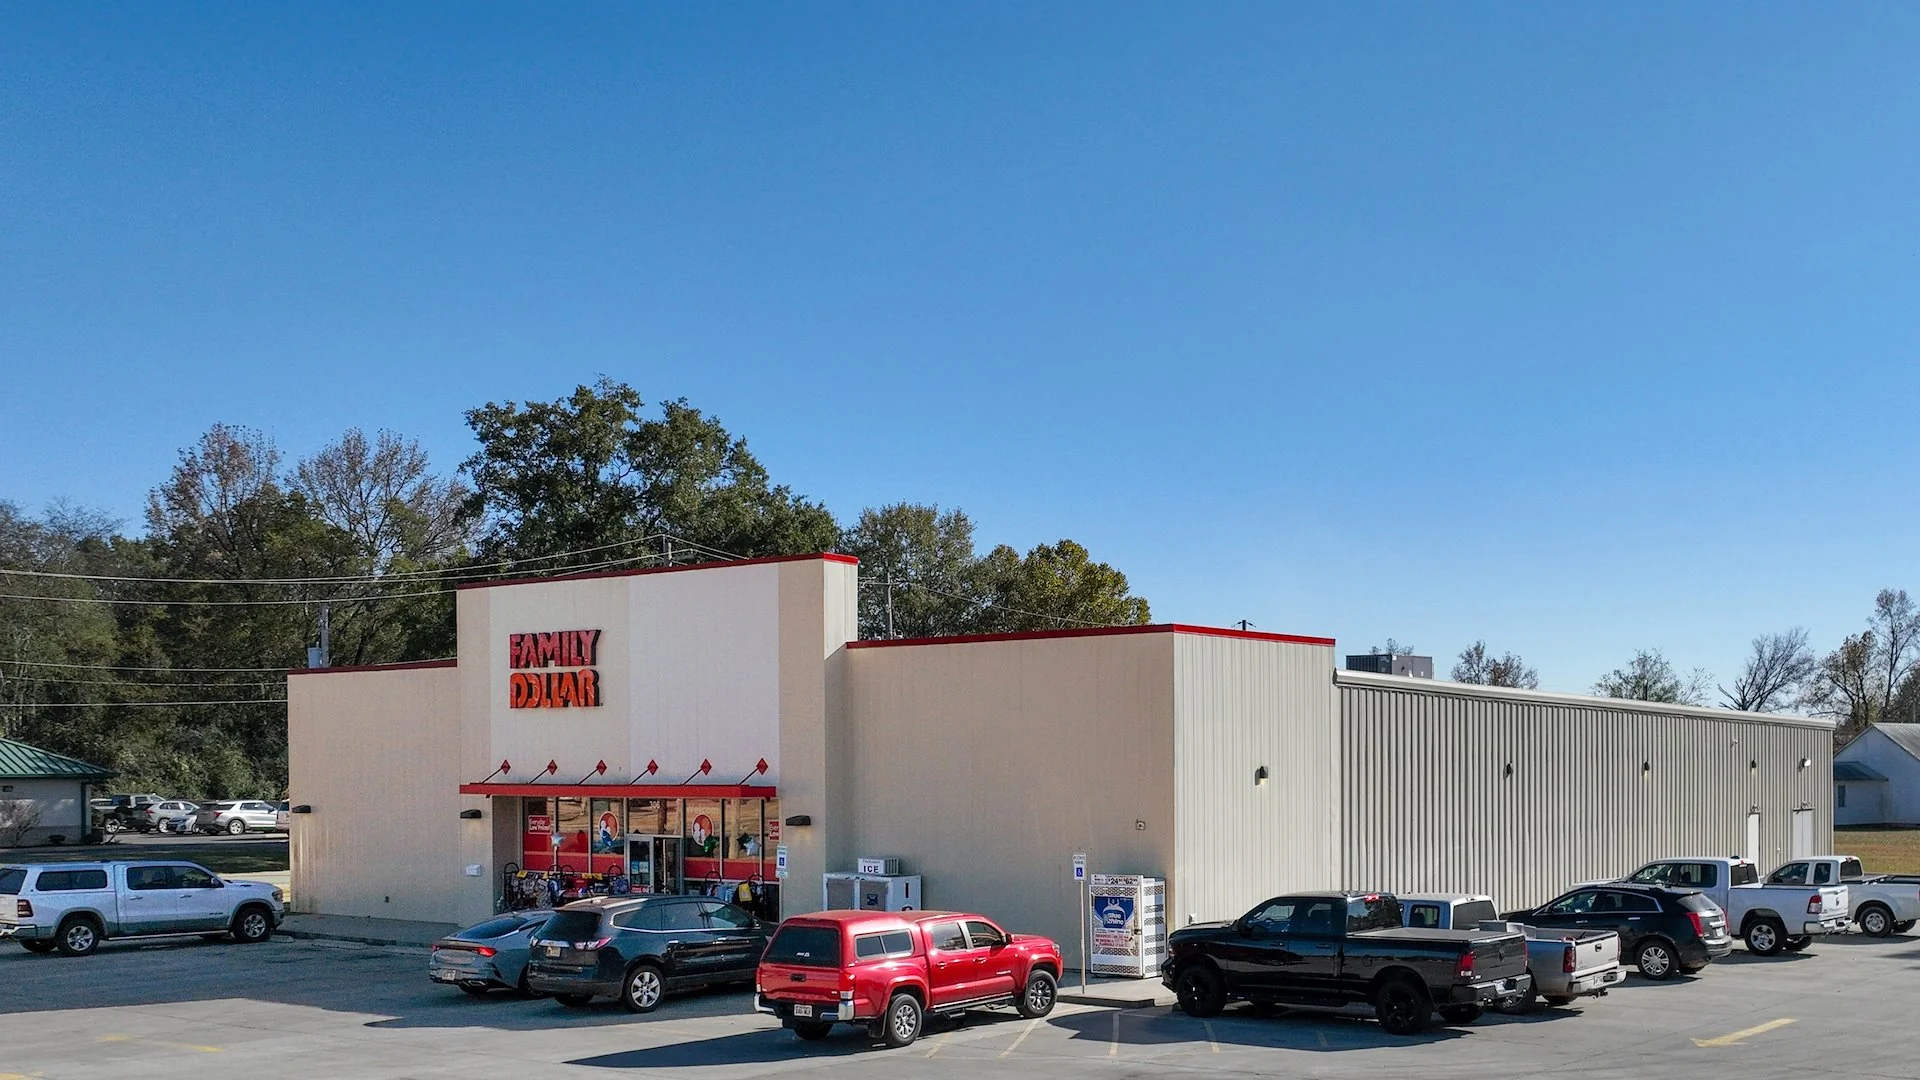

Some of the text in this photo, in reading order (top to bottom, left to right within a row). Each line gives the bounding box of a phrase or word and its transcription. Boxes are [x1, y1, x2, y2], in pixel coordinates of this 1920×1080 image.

[509, 630, 601, 669] FAMILY
[509, 669, 600, 708] DOLLAR
[863, 865, 879, 873] ICE
